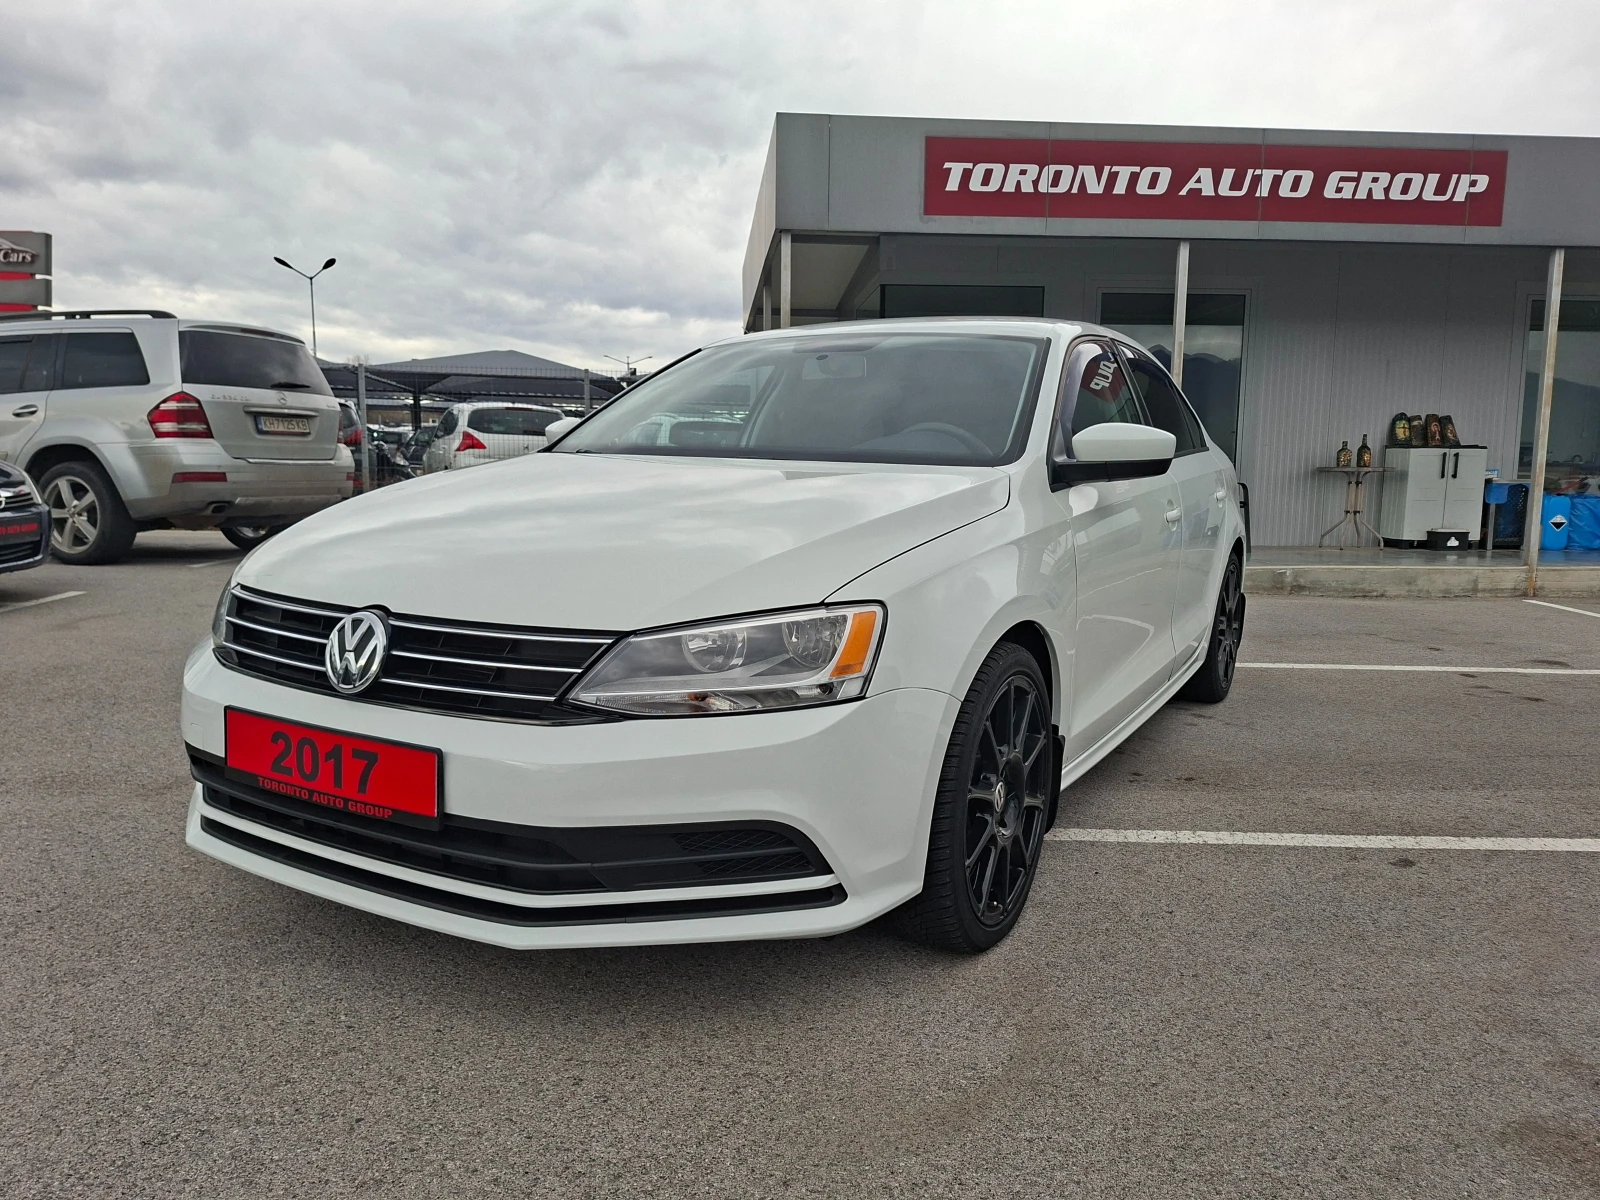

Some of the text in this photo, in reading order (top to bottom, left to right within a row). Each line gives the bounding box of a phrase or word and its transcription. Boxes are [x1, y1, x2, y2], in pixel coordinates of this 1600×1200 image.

[943, 162, 1490, 202] TORONTO AUTO GROUP
[0, 250, 33, 263] Cars
[270, 731, 380, 795] 2017
[257, 777, 393, 818] TORONTO AUTO GROUP
